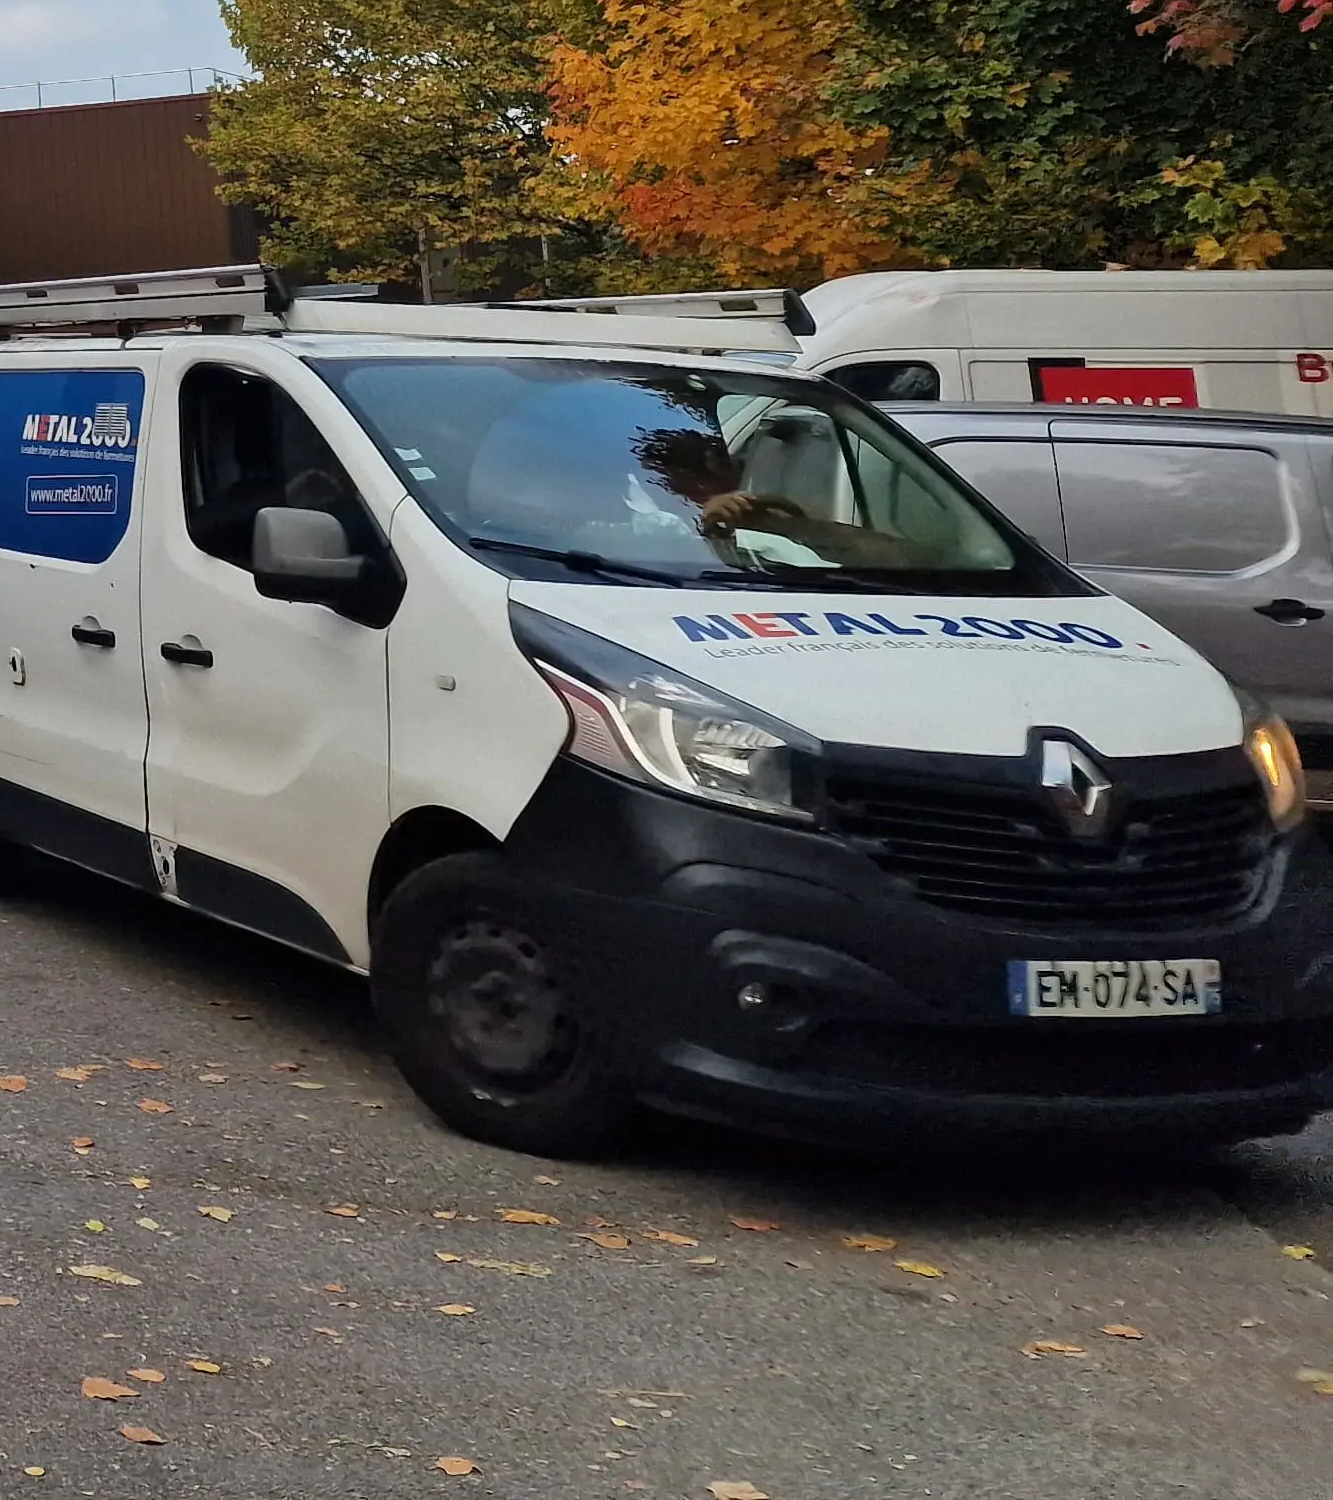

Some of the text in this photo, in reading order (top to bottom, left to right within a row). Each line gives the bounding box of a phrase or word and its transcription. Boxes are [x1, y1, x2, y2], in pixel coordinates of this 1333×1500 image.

[1296, 353, 1333, 383] B
[22, 414, 78, 443] METAL
[30, 483, 113, 503] www.metal2000.fr
[672, 612, 1124, 649] METAL 2000
[704, 642, 787, 660] Leader
[786, 639, 880, 656] français
[880, 638, 927, 650] des
[1037, 968, 1199, 1009] EM-074-SA
